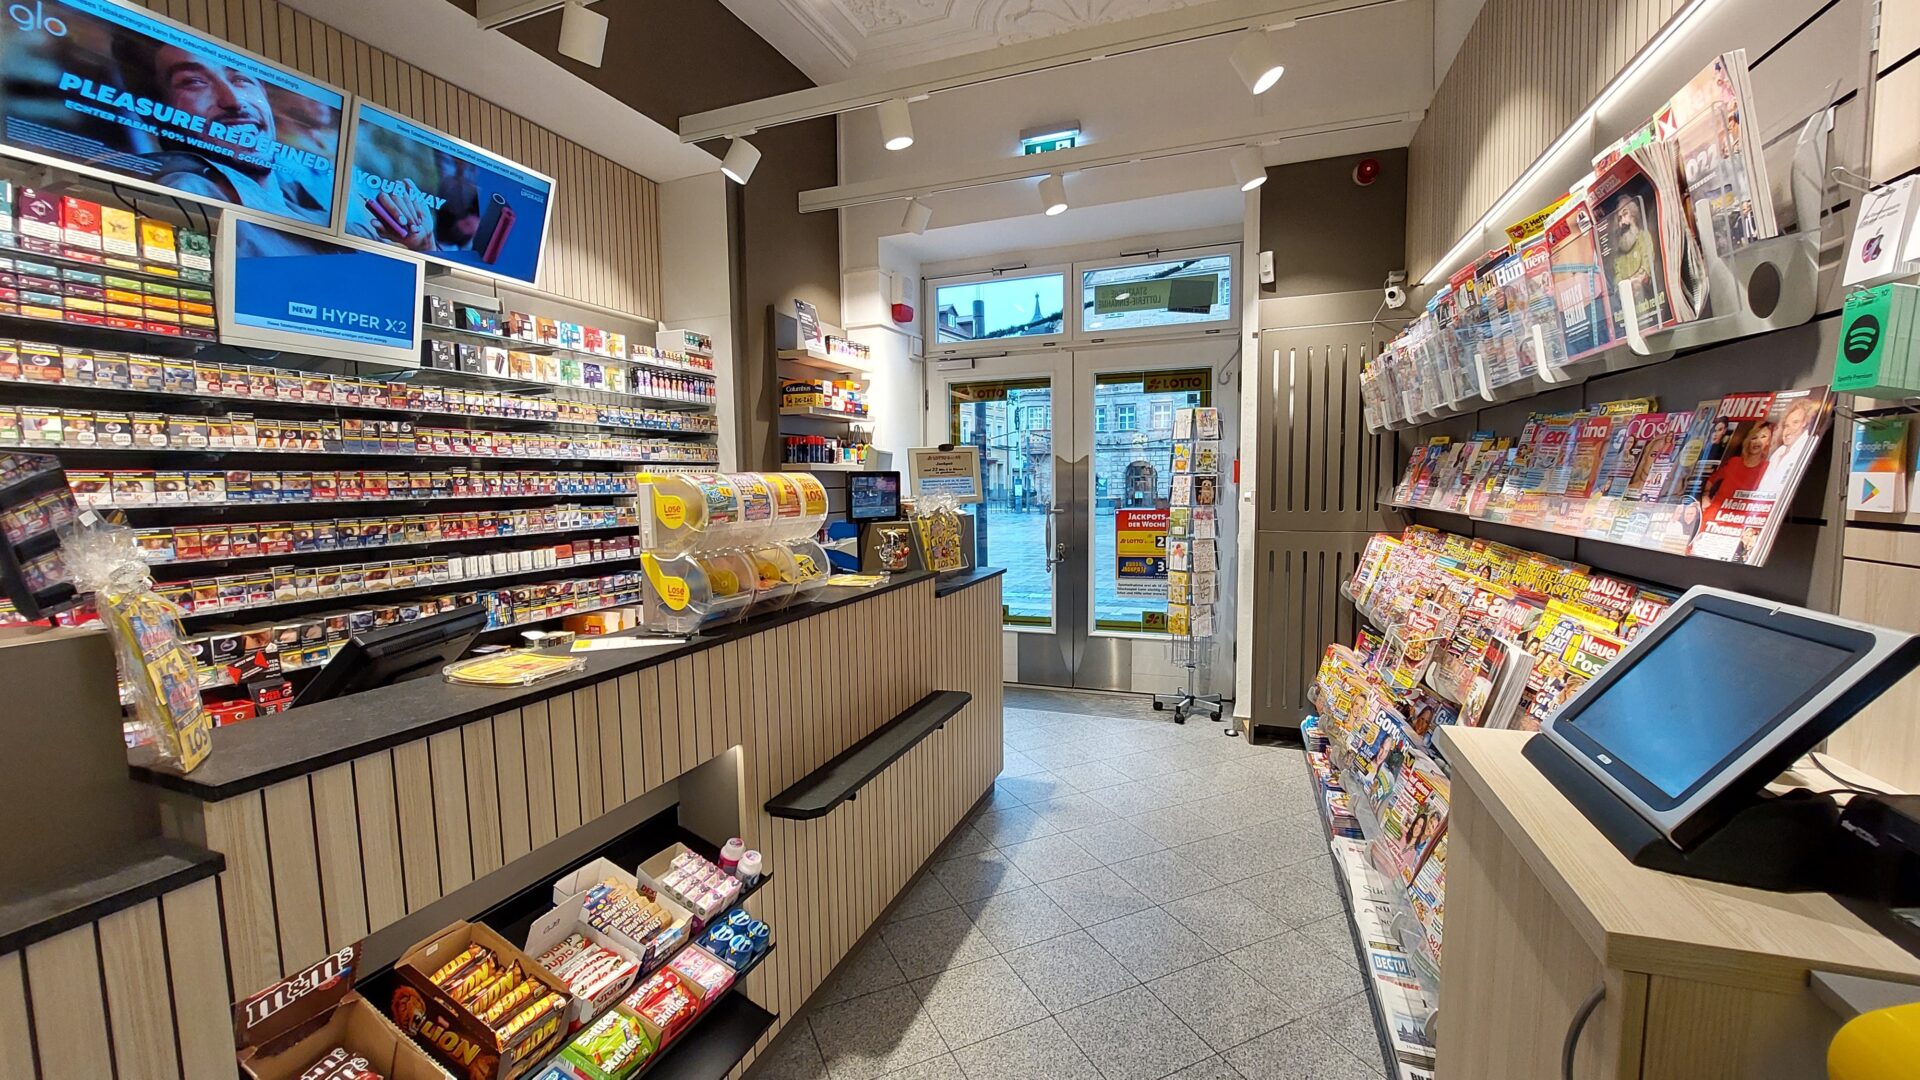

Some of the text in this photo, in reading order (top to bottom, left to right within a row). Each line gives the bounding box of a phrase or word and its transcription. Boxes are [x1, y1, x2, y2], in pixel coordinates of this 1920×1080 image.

[9, 1, 67, 37] glo
[58, 72, 207, 134] PLEASURE
[64, 100, 117, 122] ECHTER
[117, 115, 159, 136] TABAK,
[161, 129, 185, 144] 90%
[186, 136, 235, 158] WENIGER
[356, 169, 447, 211] YOUR WAY
[1523, 220, 1531, 231] 2
[1495, 261, 1525, 287] Hun
[291, 305, 314, 316] NEW
[322, 307, 380, 330] HYPER
[384, 318, 407, 335] X2
[438, 352, 449, 362] glo
[466, 355, 476, 365] glo
[785, 384, 811, 393] Columbus
[1163, 377, 1202, 390] LOTTO
[1716, 396, 1772, 419] BUNTE
[1855, 441, 1883, 452] Google
[663, 503, 681, 514] Lose
[1127, 512, 1166, 521] JACKPOTS
[1721, 498, 1773, 513] Mein neues
[1705, 521, 1743, 537] Thomas
[1714, 509, 1767, 526] Leben ohne
[666, 583, 685, 595] Lose
[1599, 577, 1632, 600] ADEL
[1594, 592, 1628, 611] privat
[1632, 600, 1660, 623] RET
[1580, 634, 1617, 660] Neue
[1572, 652, 1601, 675] Pos
[1375, 709, 1401, 744] Gong
[430, 950, 474, 985] LION
[1374, 955, 1408, 974] ВЕСТИ
[625, 973, 665, 1009] Skittles
[507, 998, 551, 1032] LION
[653, 995, 690, 1028] Skittles
[420, 1020, 481, 1066] LION
[600, 1034, 642, 1075] Skittles
